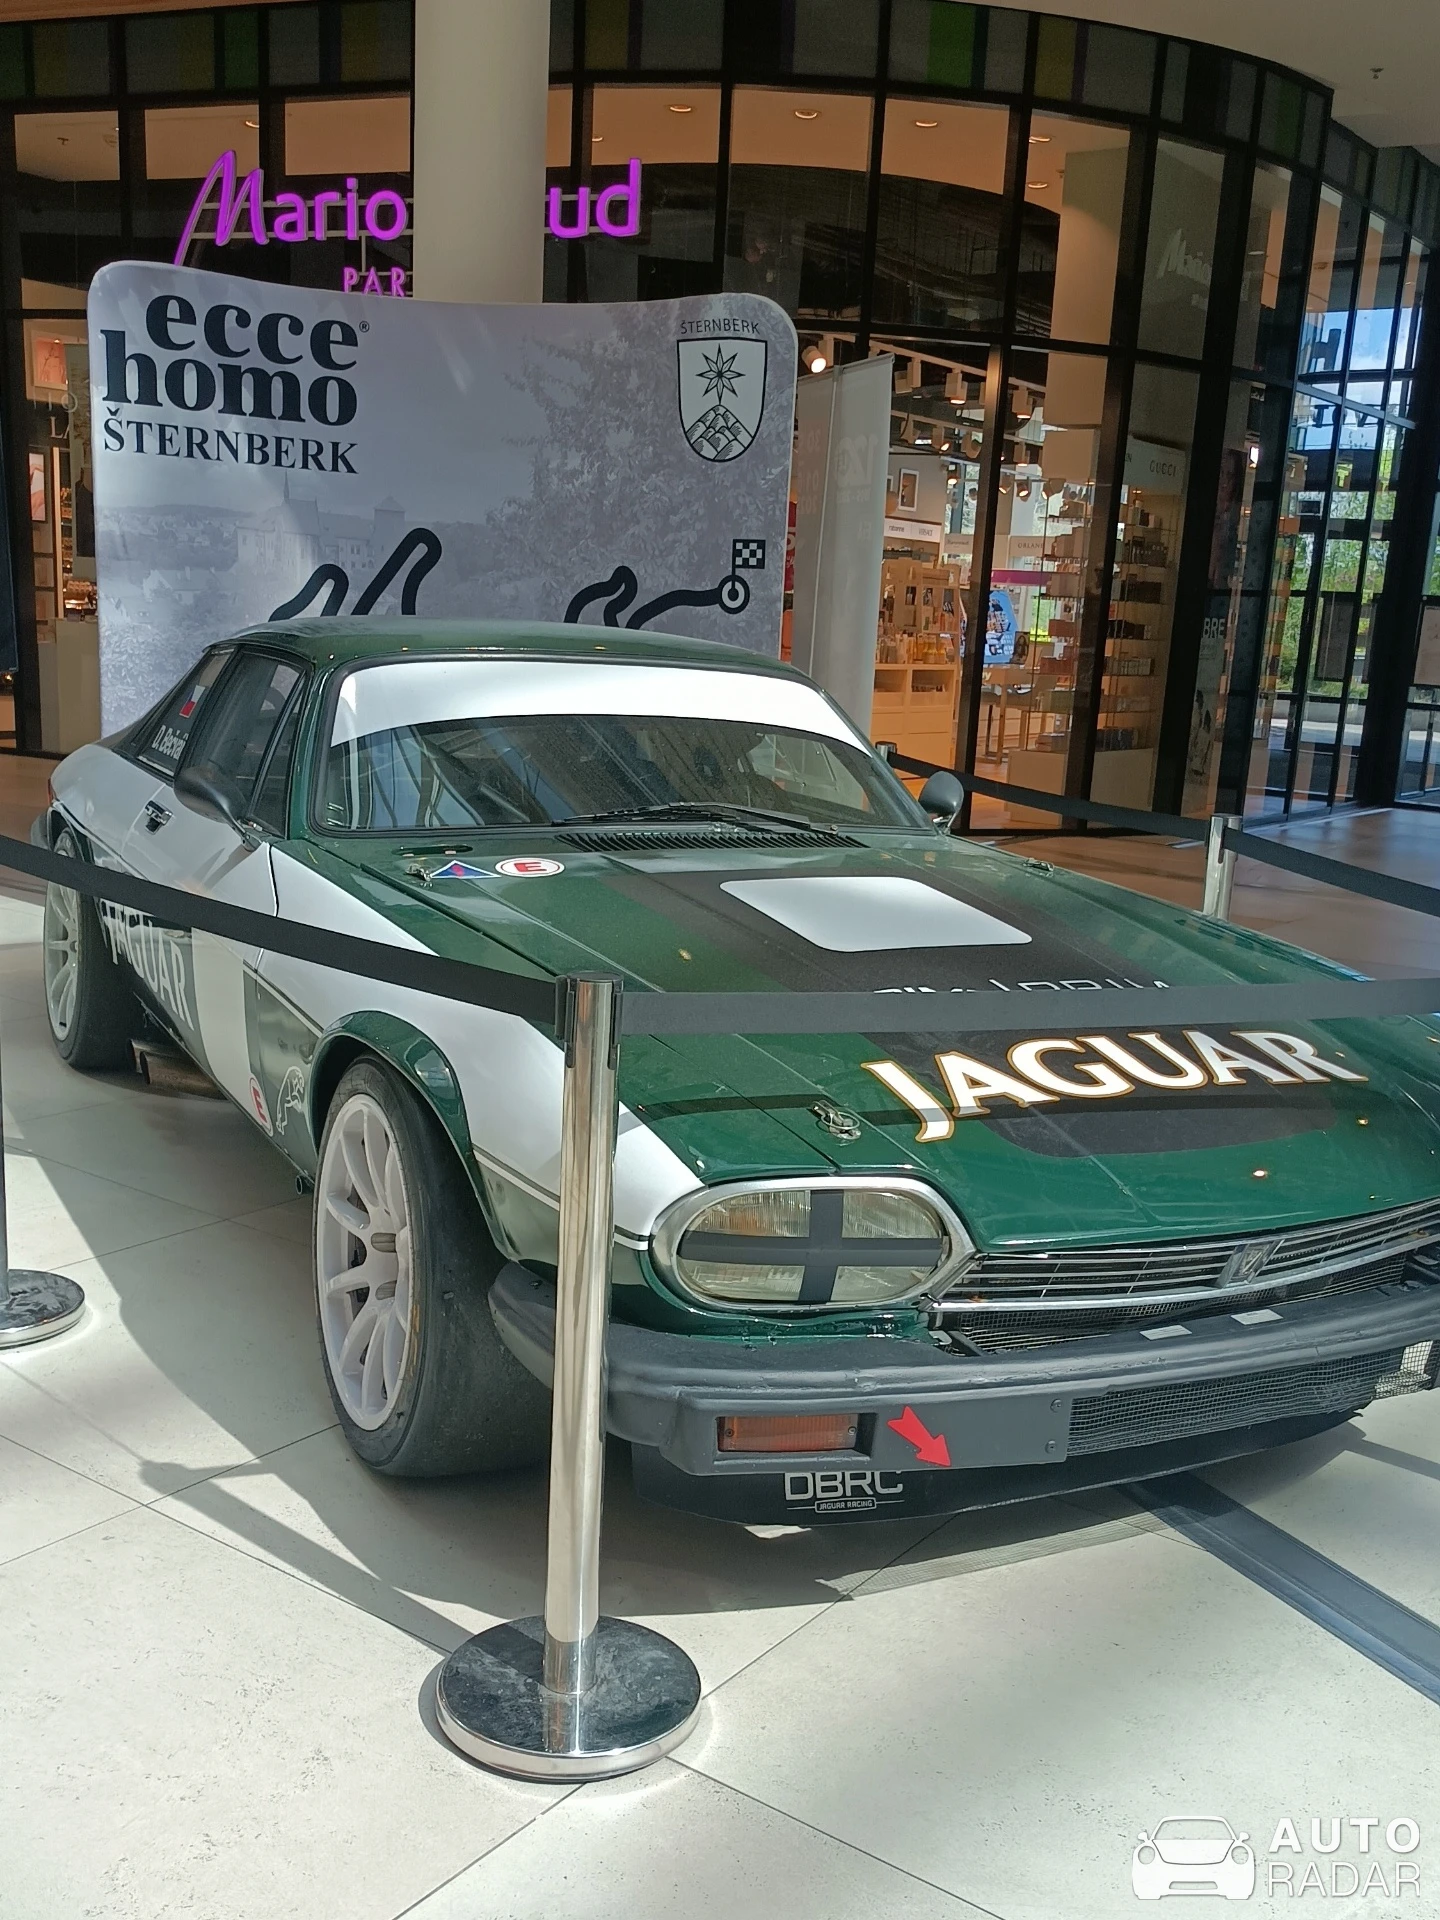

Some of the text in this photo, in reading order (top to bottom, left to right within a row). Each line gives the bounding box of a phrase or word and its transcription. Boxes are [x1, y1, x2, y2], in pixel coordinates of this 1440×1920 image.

[100, 329, 358, 426] homo
[104, 407, 359, 474] ŠTERNBERK
[860, 1029, 1369, 1143] JAGUAR
[784, 1471, 904, 1501] DBRC
[819, 1500, 873, 1511] JAGUAR RACING
